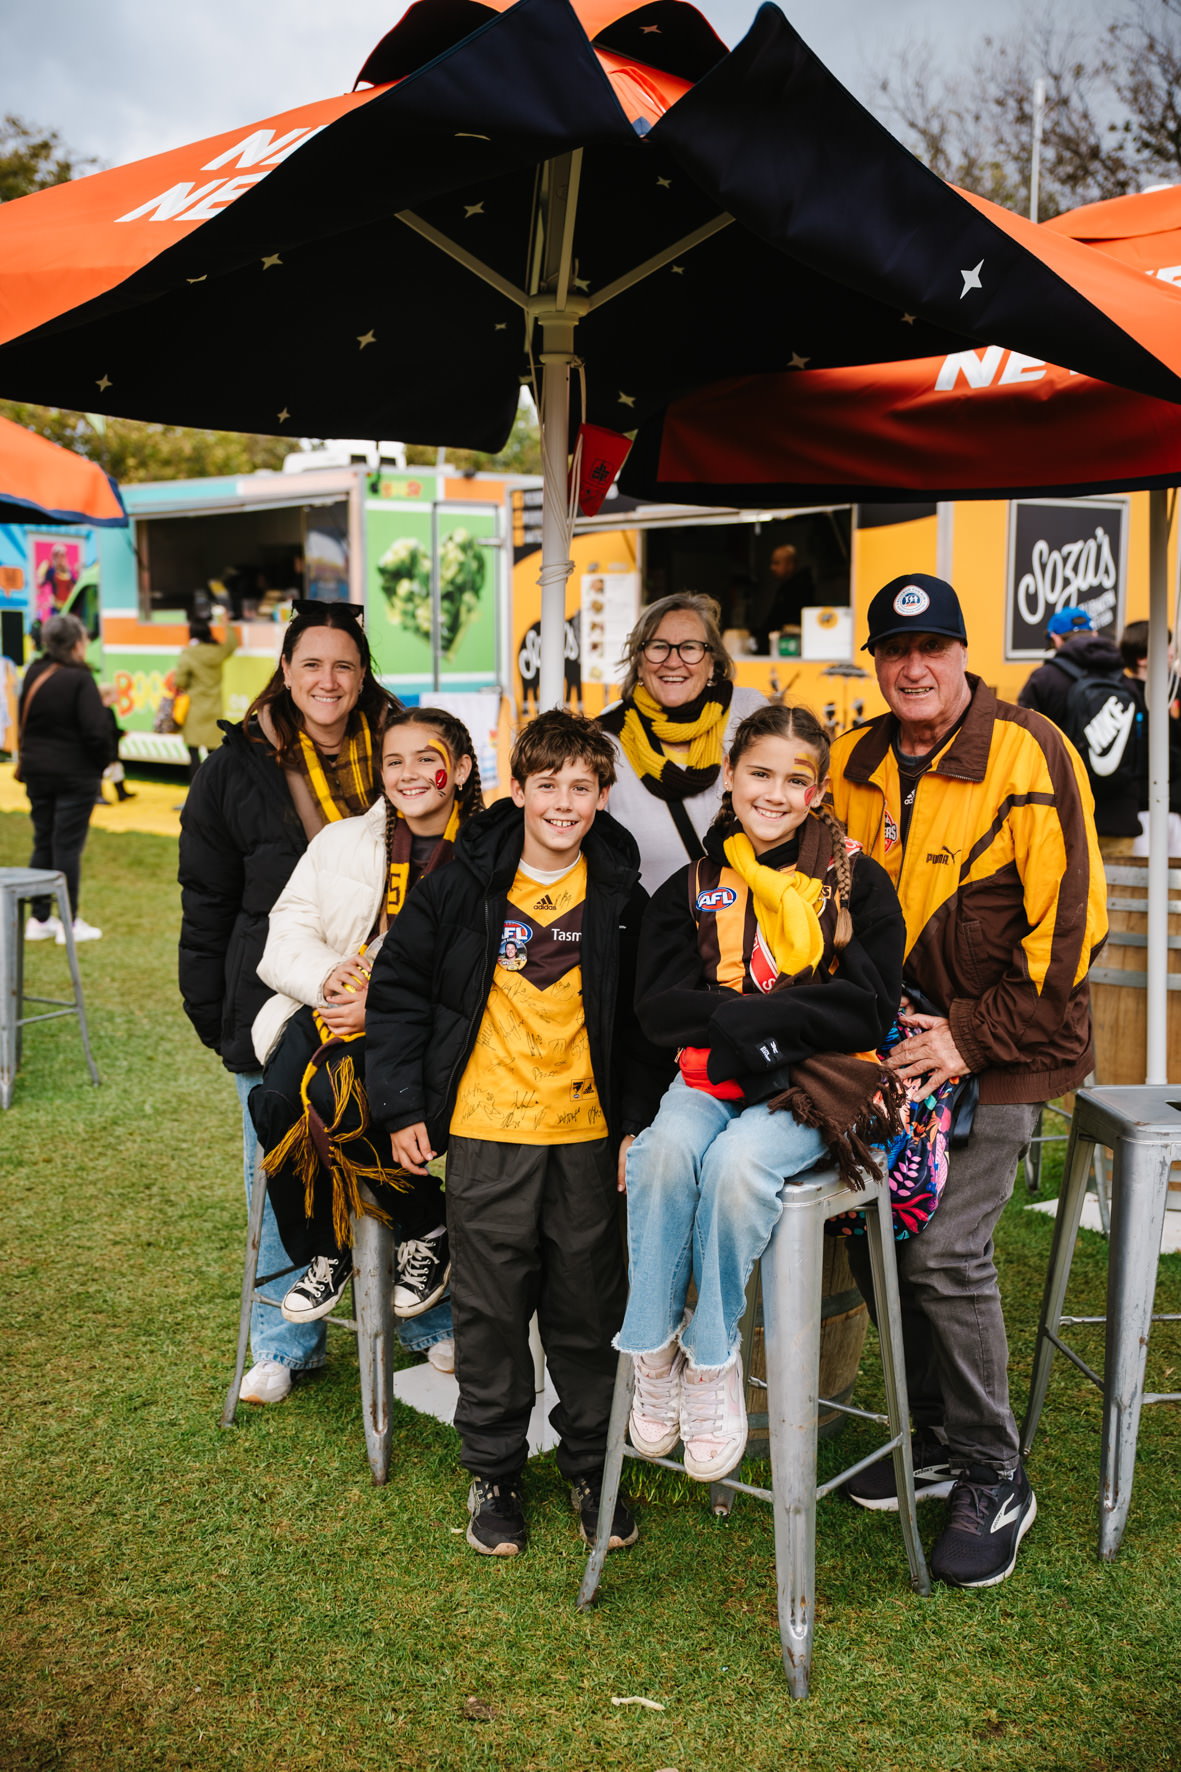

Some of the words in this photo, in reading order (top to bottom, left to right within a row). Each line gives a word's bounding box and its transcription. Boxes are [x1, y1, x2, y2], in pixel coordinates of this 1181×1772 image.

[1083, 695, 1125, 755] NIKE
[925, 853, 949, 865] PUMA
[698, 891, 733, 908] AFL
